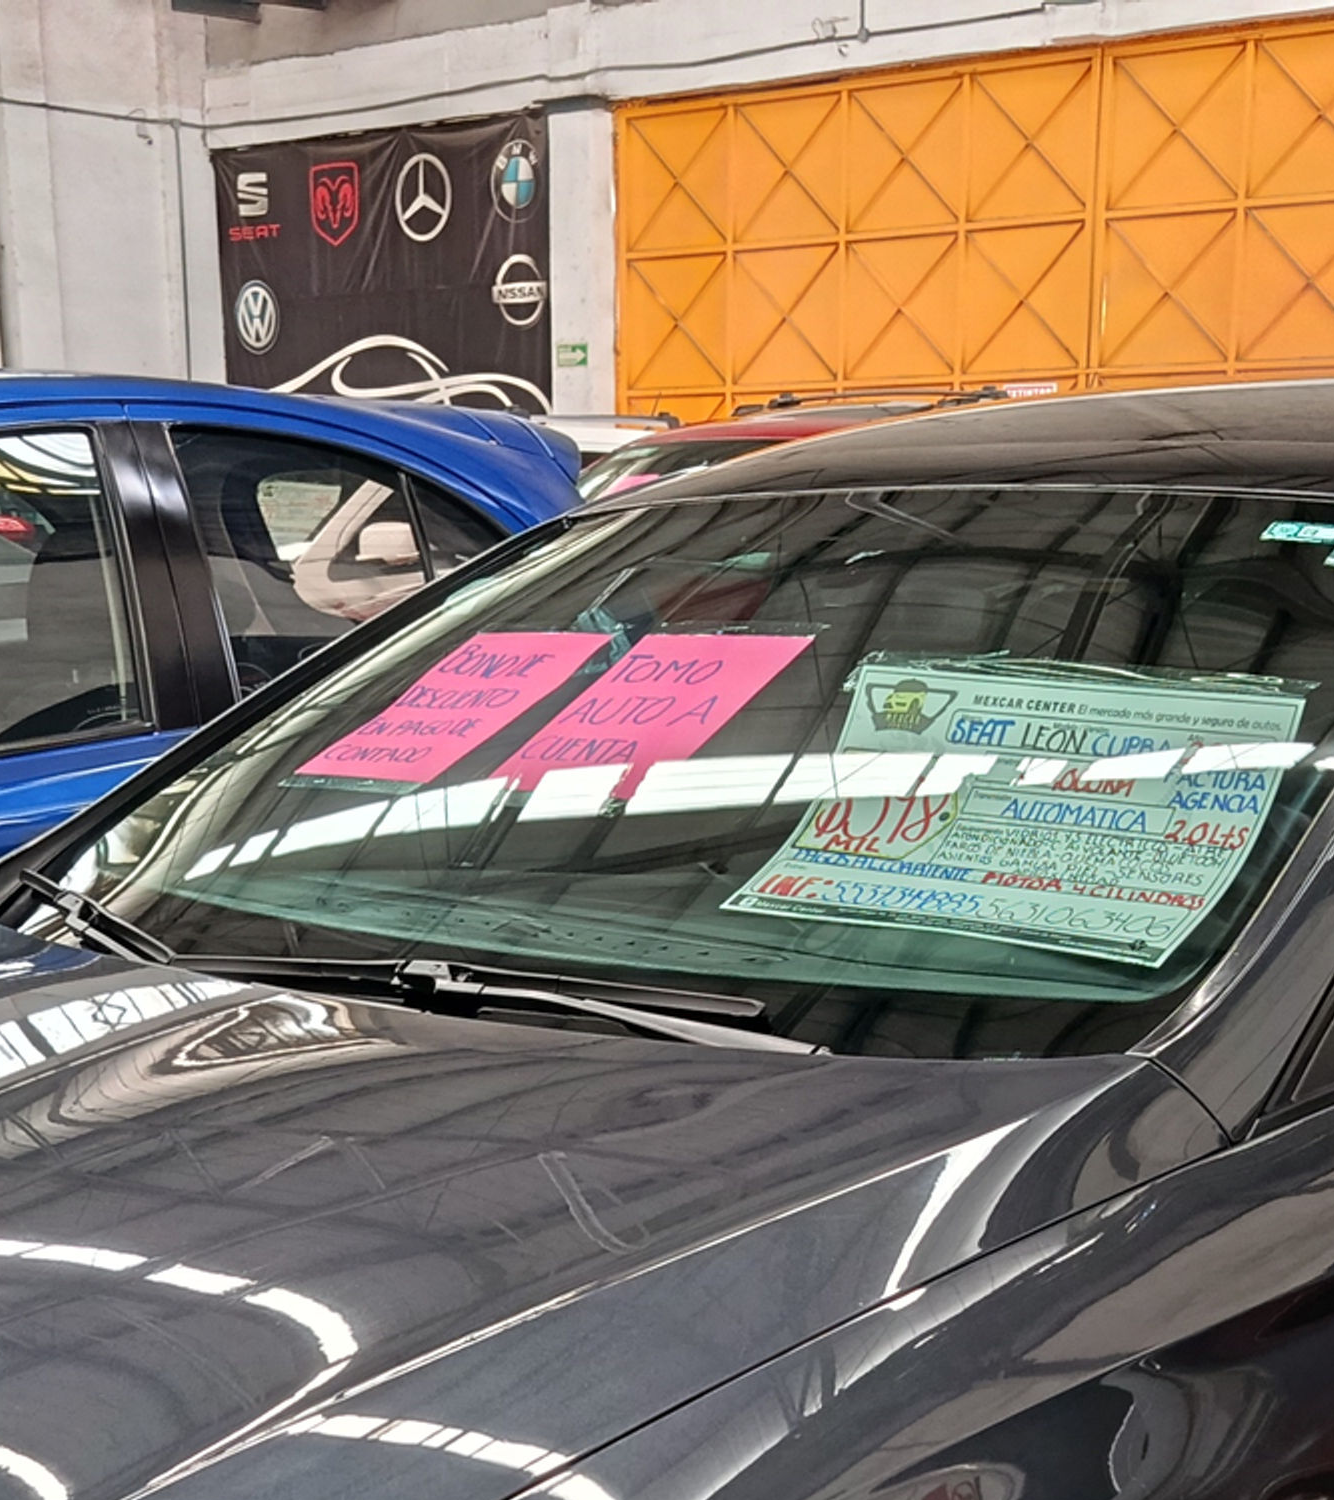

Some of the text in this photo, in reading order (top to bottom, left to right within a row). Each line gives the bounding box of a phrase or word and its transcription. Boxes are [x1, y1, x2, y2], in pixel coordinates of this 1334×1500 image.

[229, 224, 280, 241] SEAT
[439, 644, 519, 678] BONO
[612, 654, 723, 685] TOMO
[395, 685, 519, 709] DESCUENTO
[559, 695, 720, 726] AUTO A
[974, 694, 1023, 709] MEXCAR
[1026, 699, 1077, 715] CENTER
[1089, 705, 1132, 720] mercado
[1155, 711, 1191, 727] grande
[1201, 716, 1235, 732] seguro
[1237, 717, 1251, 730] de
[356, 718, 482, 737] EN PAGO DE
[951, 718, 1016, 746] SEAT
[1021, 721, 1087, 755] LEON
[322, 745, 432, 764] CONTADO
[520, 736, 640, 764] CUENTA
[1169, 789, 1260, 815] AGENCIA
[1000, 798, 1147, 834] AUTOMATICA
[823, 834, 880, 853] MIL
[757, 874, 834, 899] INF:
